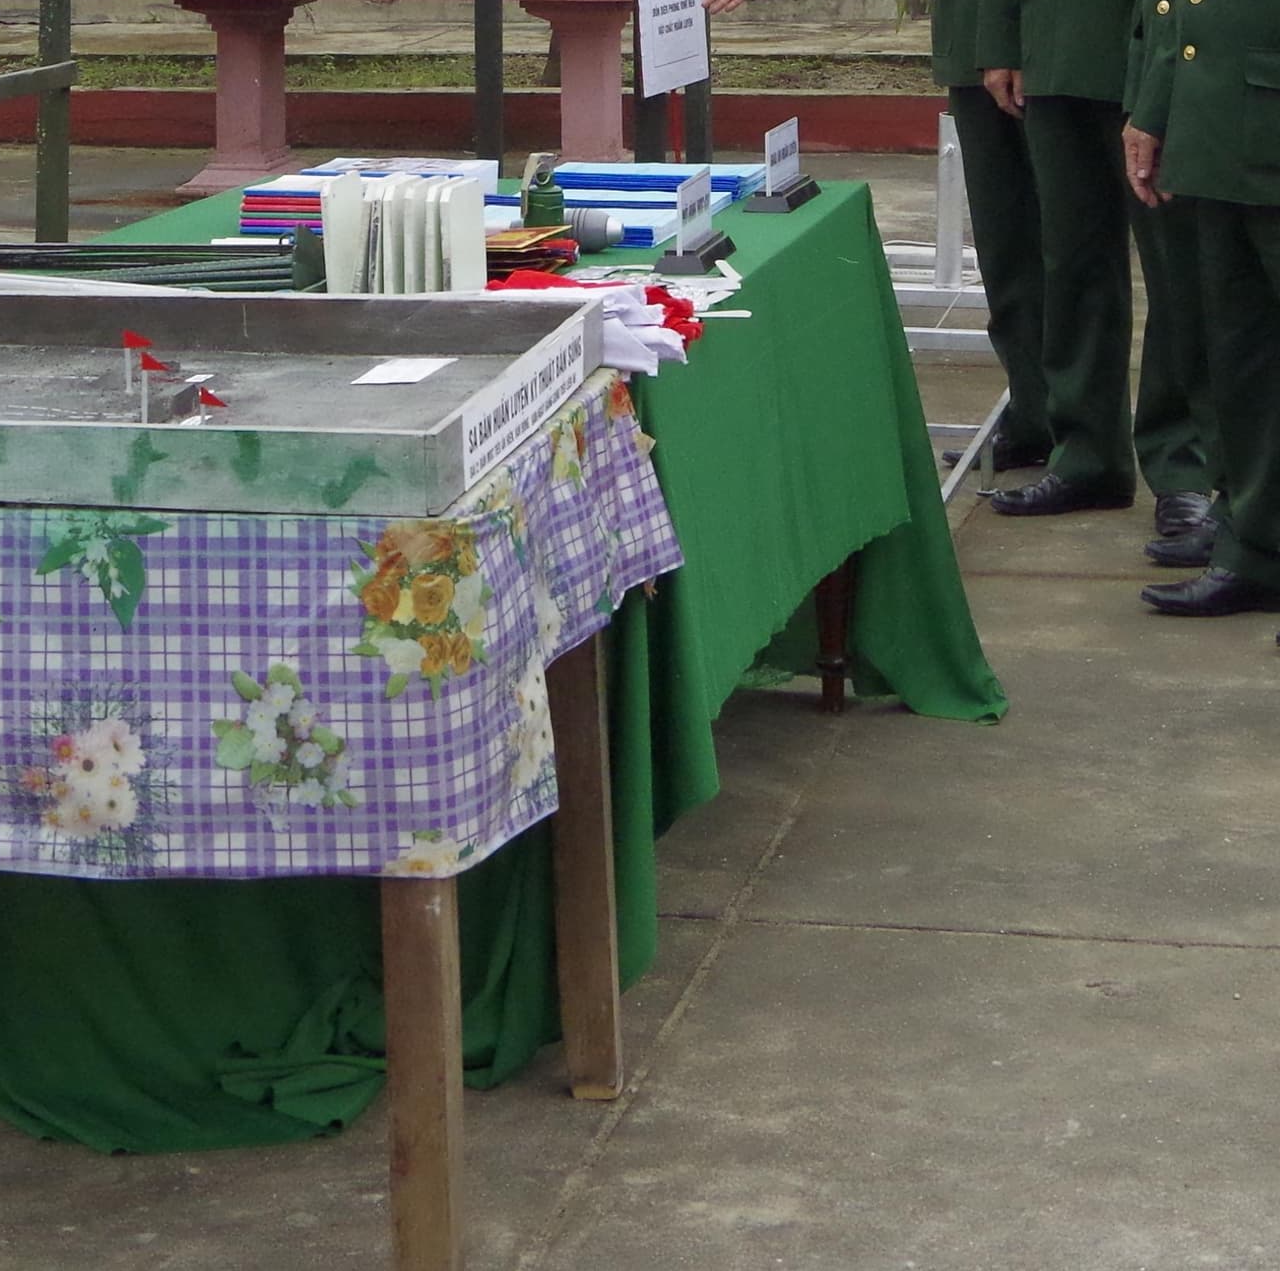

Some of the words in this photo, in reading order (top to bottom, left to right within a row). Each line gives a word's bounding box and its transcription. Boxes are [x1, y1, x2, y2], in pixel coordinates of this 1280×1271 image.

[468, 425, 478, 454] SA
[478, 412, 492, 446] BÀN
[492, 392, 510, 434] HUẤN
[510, 381, 529, 419] LUYỆN
[538, 357, 556, 395] THUẬT
